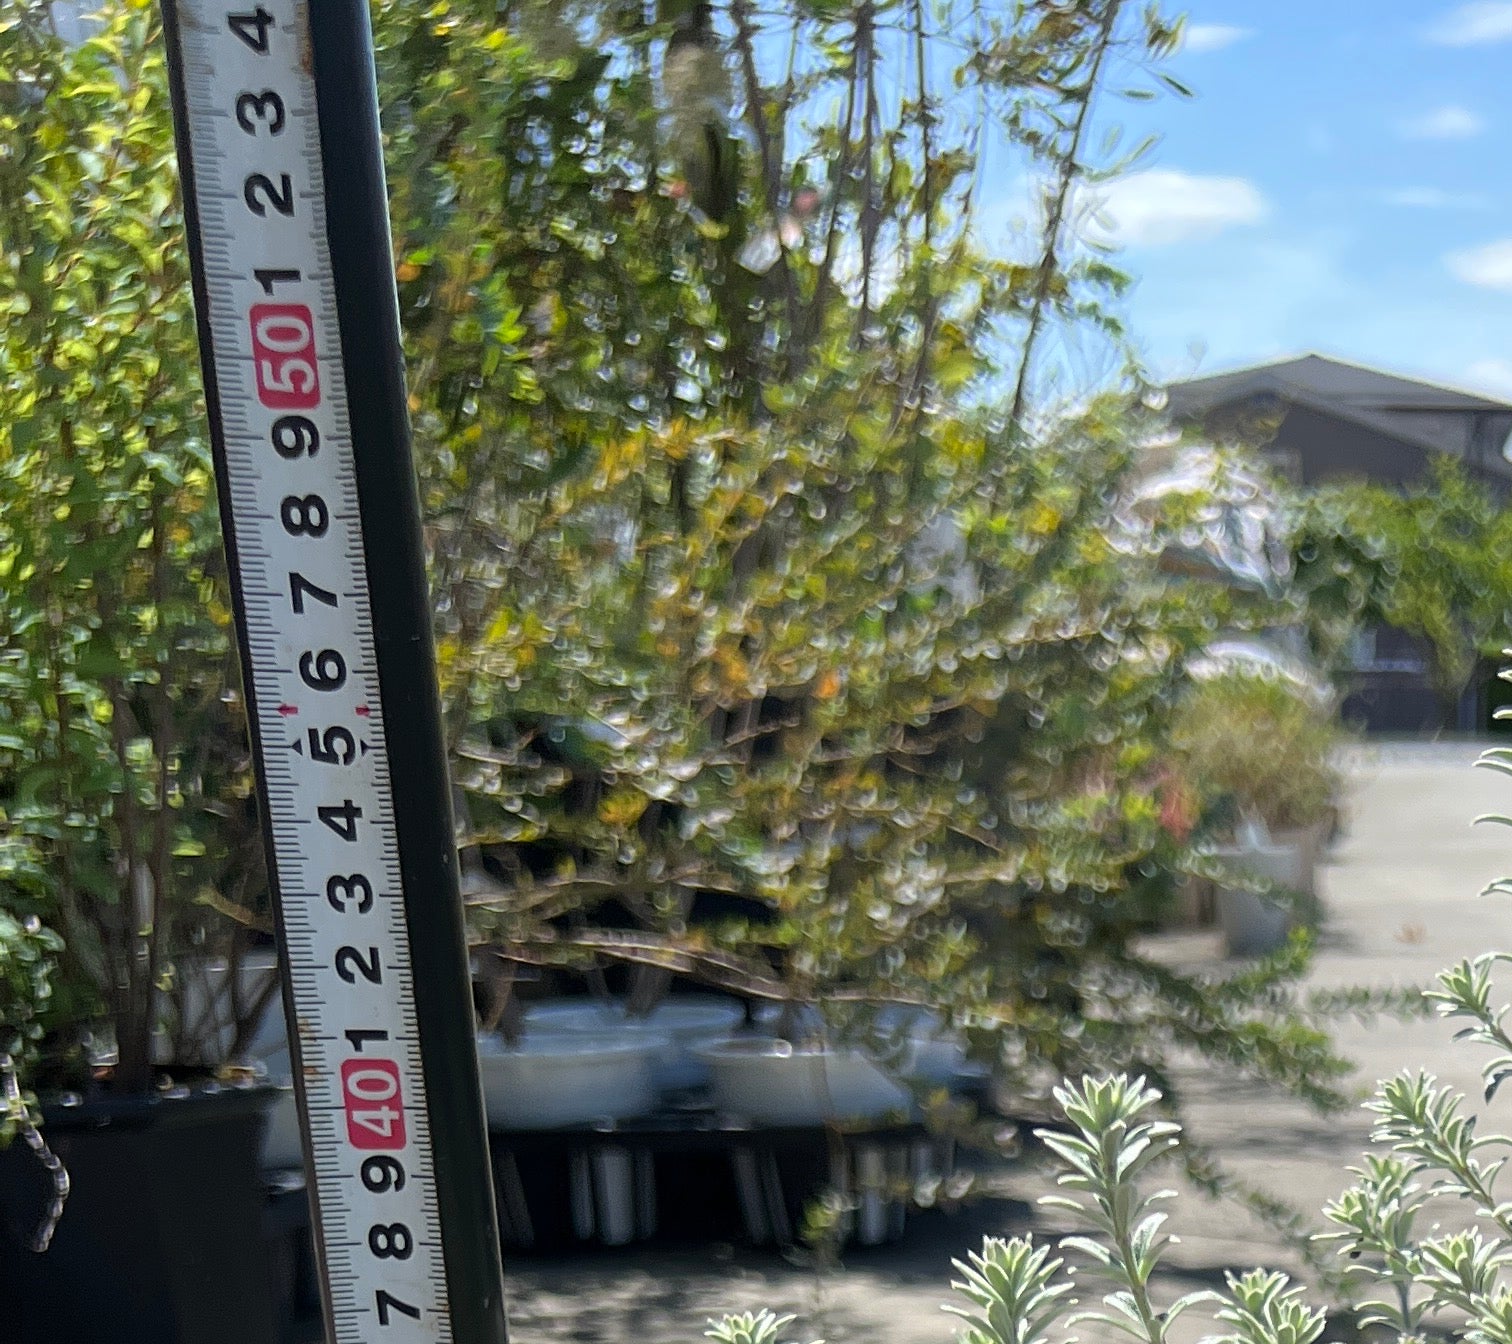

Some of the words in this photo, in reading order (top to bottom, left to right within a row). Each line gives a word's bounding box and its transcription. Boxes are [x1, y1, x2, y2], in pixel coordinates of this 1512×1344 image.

[228, 6, 275, 54] 4
[236, 89, 285, 136] 3
[244, 173, 294, 216] 2
[254, 269, 301, 295] 1
[256, 315, 315, 394] 50
[272, 416, 319, 459] 9
[281, 494, 328, 537] 8
[289, 572, 338, 613] 7
[299, 649, 346, 691] 6
[308, 726, 355, 765] 5
[318, 800, 362, 841] 4
[327, 874, 373, 913] 3
[335, 946, 382, 984] 2
[345, 1030, 388, 1052] 1
[347, 1069, 400, 1137] 40
[361, 1155, 405, 1193] 9
[368, 1223, 413, 1260] 8
[376, 1290, 420, 1325] 7
